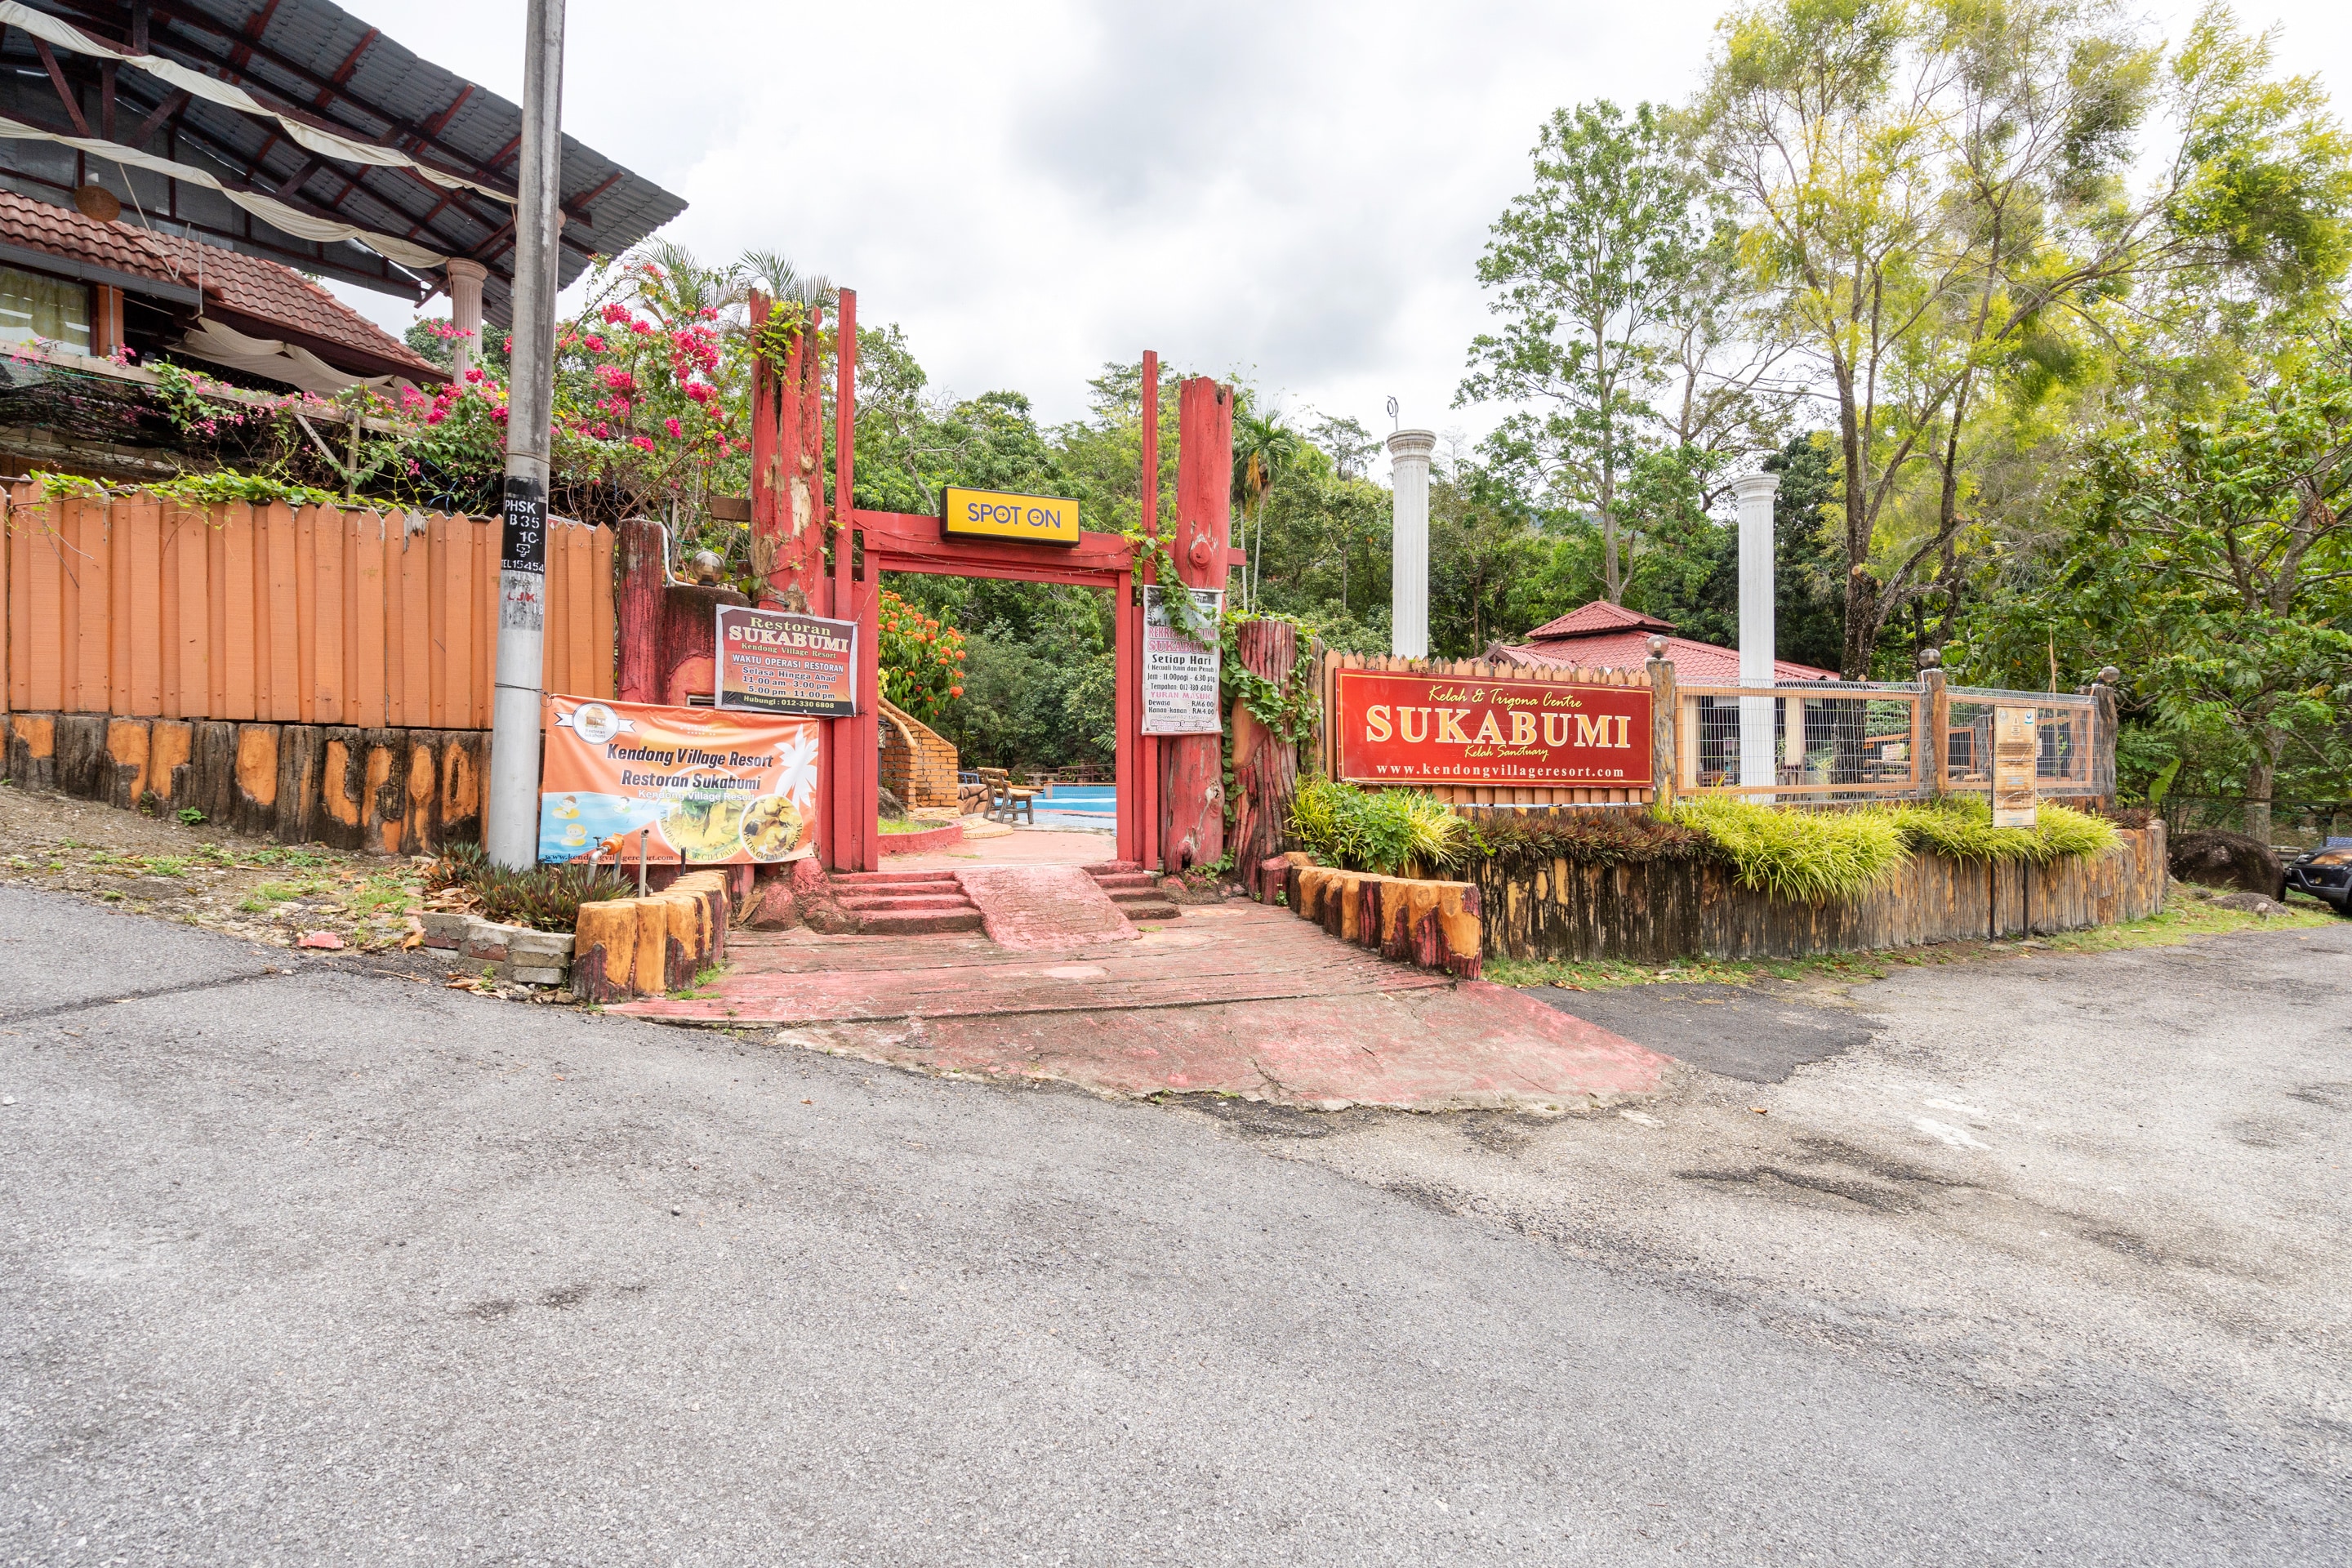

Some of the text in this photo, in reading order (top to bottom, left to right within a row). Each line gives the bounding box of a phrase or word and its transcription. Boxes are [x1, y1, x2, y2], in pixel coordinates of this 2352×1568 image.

[505, 499, 536, 514] PHSK
[968, 502, 1061, 528] SPOT ON
[750, 617, 831, 636] Restoran
[728, 625, 849, 653] SUKABUMI
[742, 642, 837, 659] Kendong Village Resort
[732, 654, 844, 673] WAKTU OPERASI RESTORAN
[1152, 654, 1211, 666] Setiap Hari
[742, 666, 836, 682] Selasa Hingga Ahad
[742, 675, 770, 685] 11.00
[793, 680, 814, 690] 3.00
[748, 685, 770, 694] 5.00
[794, 690, 821, 698] 11.00
[1182, 692, 1211, 700] MASUK
[1428, 684, 1583, 712] Kelah & Trigona Centre
[1365, 705, 1632, 749] SUKABUMI
[607, 743, 774, 768] Kendong Village Resort
[1464, 744, 1549, 762] Kelah Sanctuary
[1376, 763, 1624, 779] www.kendongvillageresort.com
[621, 769, 761, 791] Restoran Sukabumi
[638, 789, 755, 801] Kendong Village Resort
